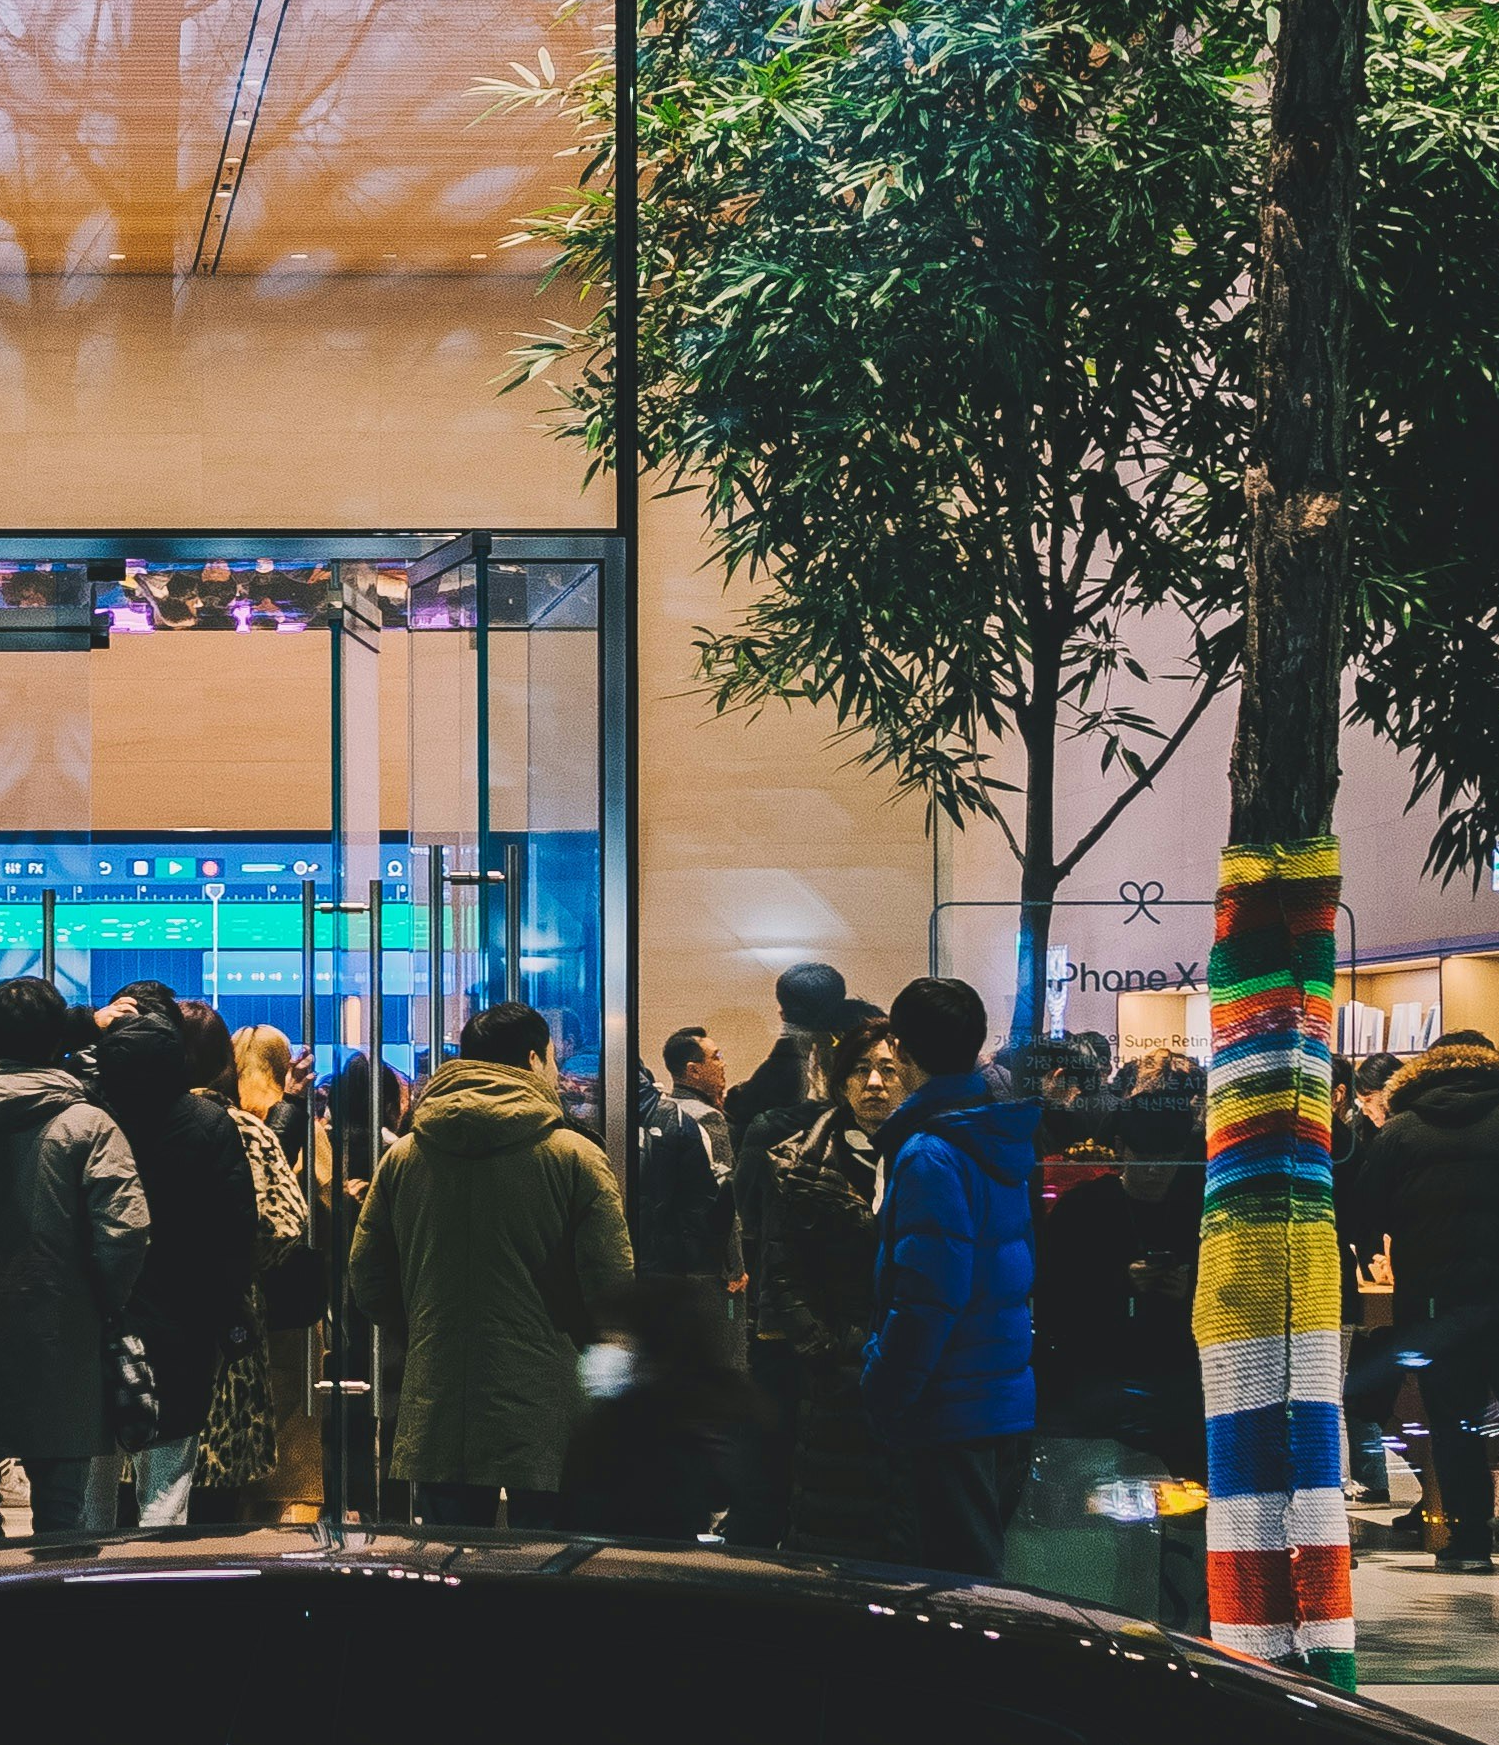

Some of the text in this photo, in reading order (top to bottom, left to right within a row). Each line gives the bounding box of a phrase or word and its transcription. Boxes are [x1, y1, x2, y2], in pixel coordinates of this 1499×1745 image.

[28, 863, 44, 874] FX
[1174, 961, 1200, 992] X
[1124, 1034, 1168, 1050] Super
[1172, 1034, 1212, 1048] Retin
[1136, 1096, 1189, 1111] 혁신적인
